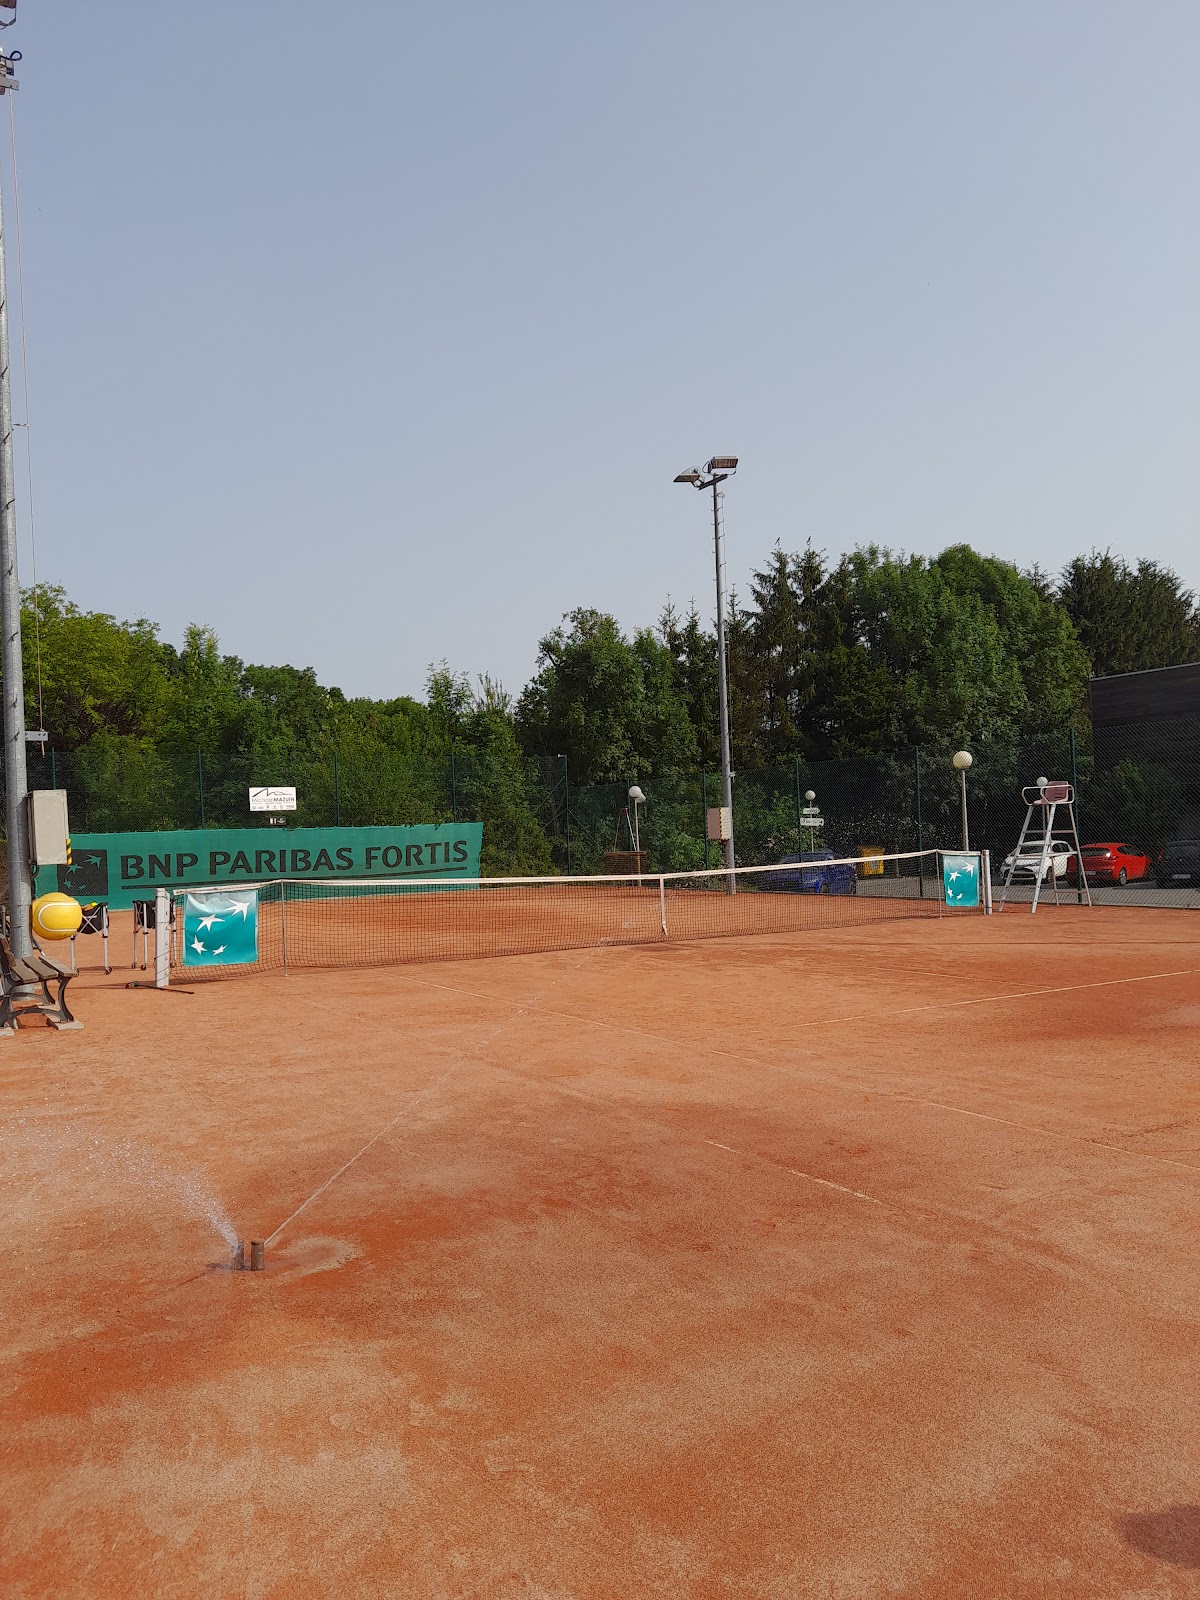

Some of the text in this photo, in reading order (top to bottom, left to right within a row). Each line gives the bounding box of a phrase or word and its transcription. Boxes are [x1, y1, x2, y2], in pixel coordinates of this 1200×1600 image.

[120, 840, 468, 880] BNP PARIBAS FORTIS
